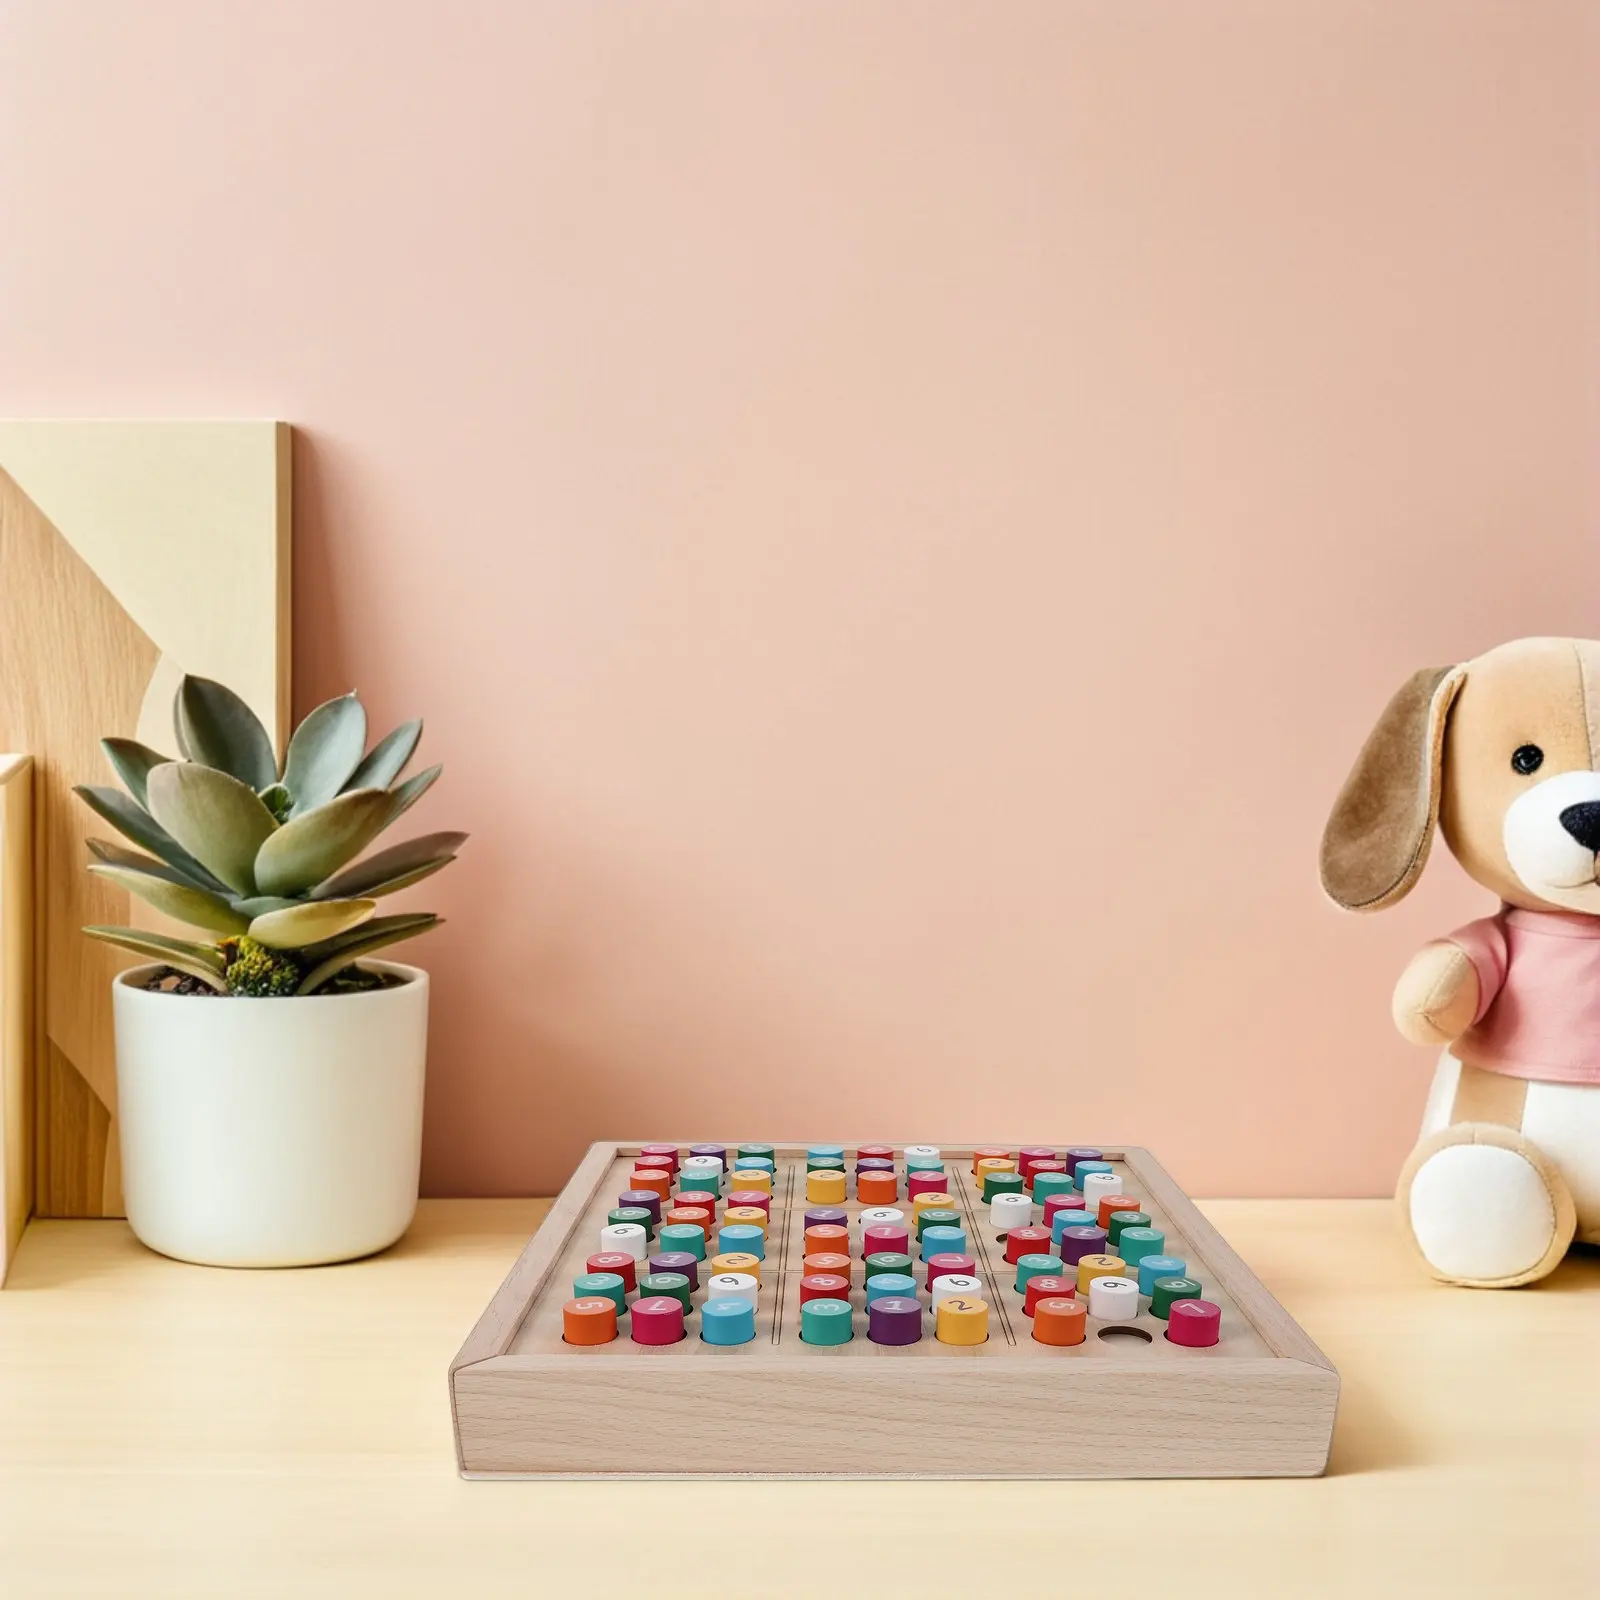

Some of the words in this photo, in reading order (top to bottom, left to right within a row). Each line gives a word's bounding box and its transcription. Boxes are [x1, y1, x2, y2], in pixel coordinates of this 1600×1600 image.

[739, 1192, 757, 1200] 7
[738, 1208, 755, 1217] 2
[815, 1210, 834, 1218] 1
[815, 1227, 834, 1236] 5
[875, 1227, 893, 1236] 7
[598, 1255, 623, 1264] 8
[661, 1254, 682, 1264] 1
[726, 1255, 749, 1265] 2
[1092, 1256, 1113, 1266] 2
[587, 1276, 610, 1287] 3
[810, 1277, 836, 1286] 8
[1039, 1278, 1059, 1289] 8
[575, 1301, 604, 1310] 5
[647, 1300, 666, 1311] 7
[812, 1303, 840, 1311] 3
[884, 1300, 903, 1311] 1
[948, 1300, 973, 1311] 2
[1048, 1301, 1076, 1310] 5
[1179, 1302, 1206, 1314] 7
